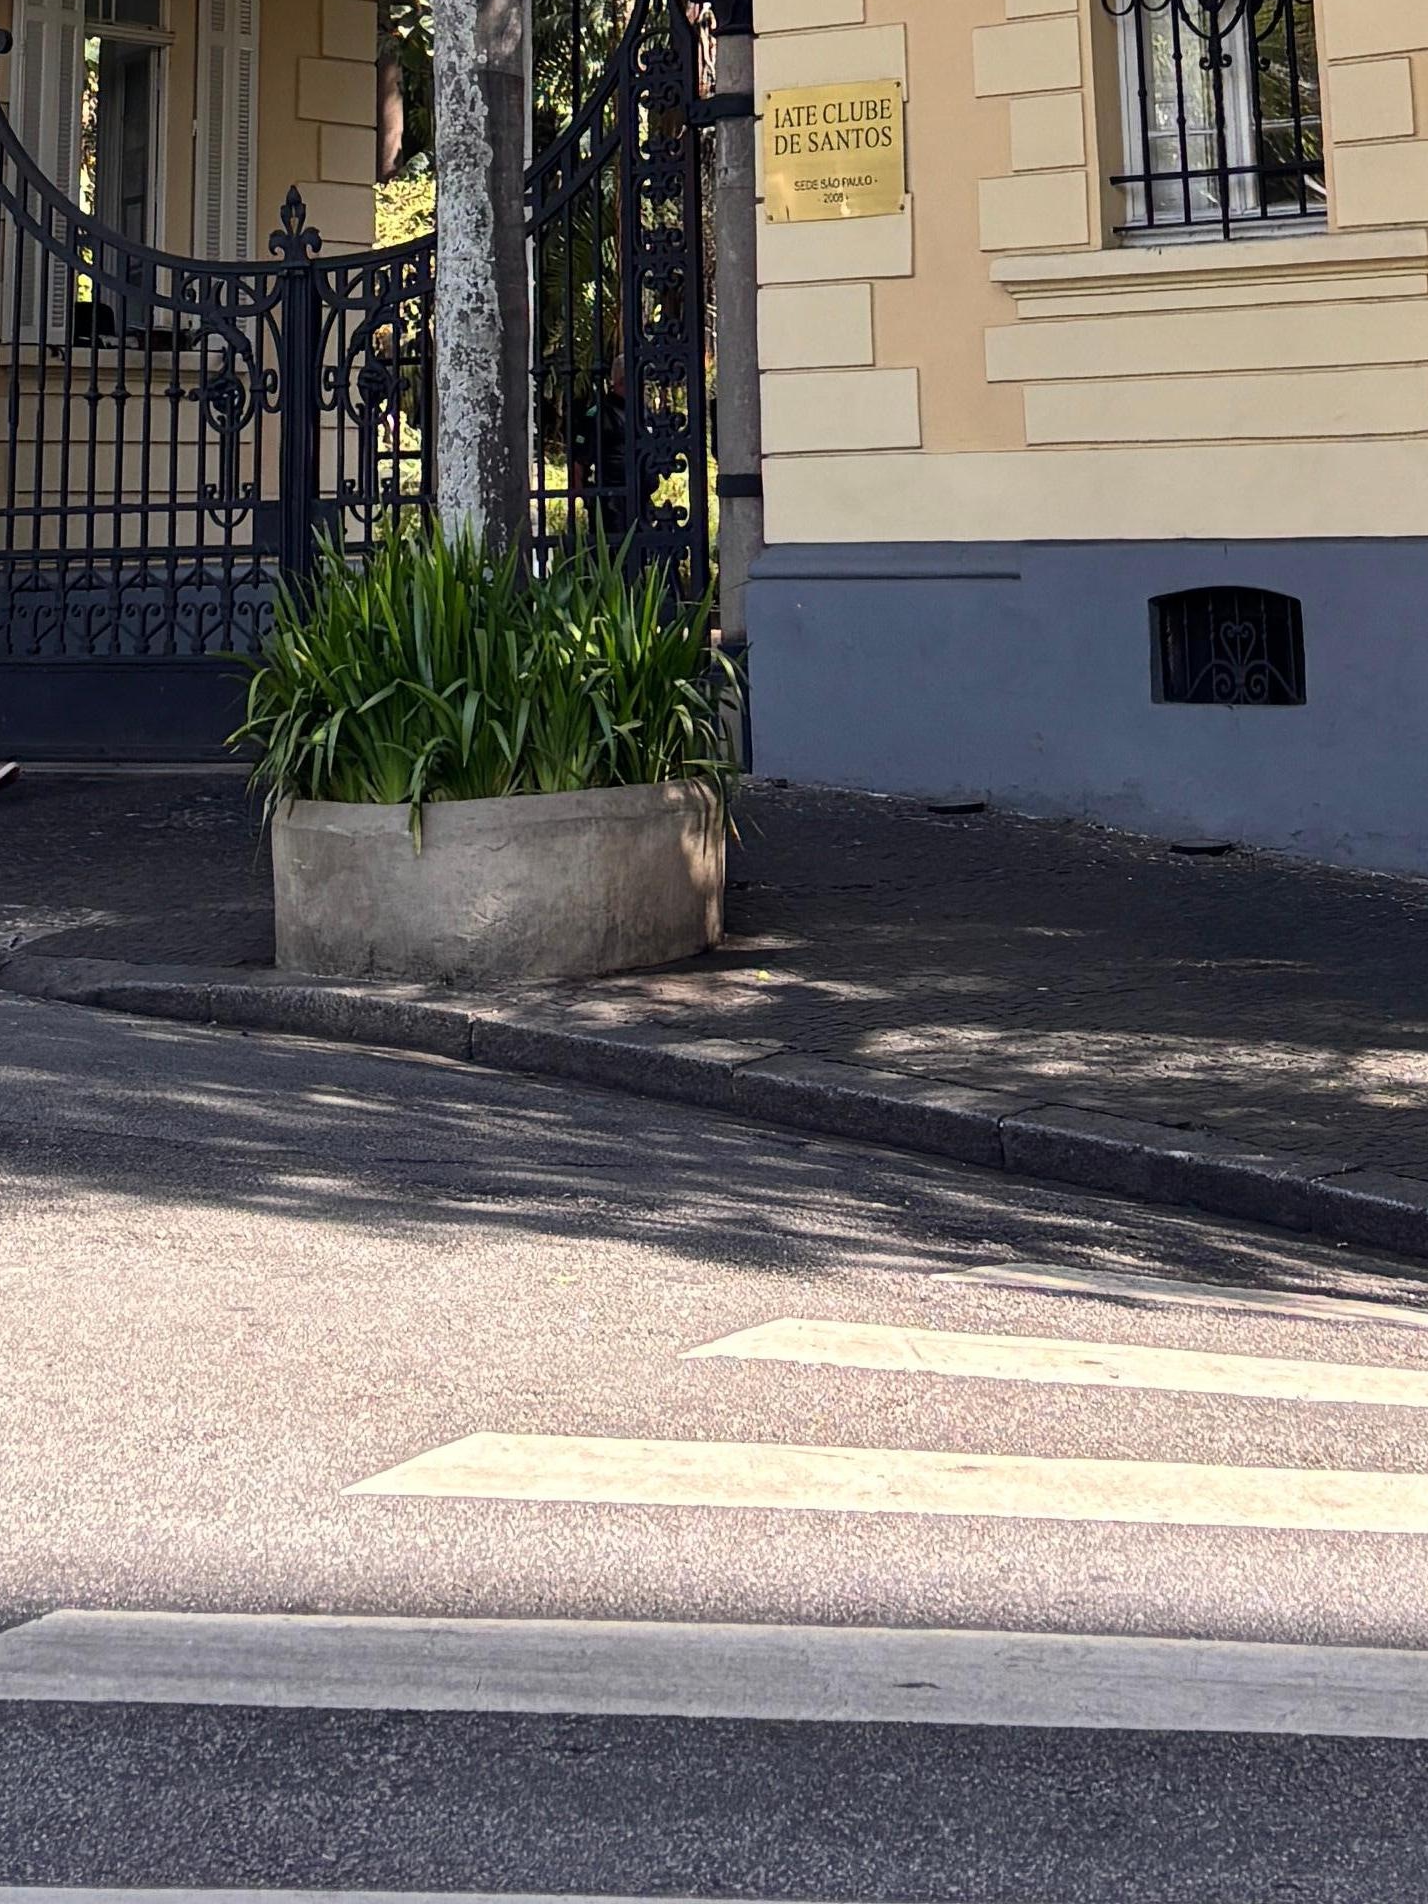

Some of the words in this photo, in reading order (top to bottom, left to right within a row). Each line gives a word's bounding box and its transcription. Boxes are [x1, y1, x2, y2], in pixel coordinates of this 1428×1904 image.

[774, 105, 818, 129] IATE
[822, 98, 893, 125] CLUBE
[774, 133, 802, 156] DE
[808, 125, 893, 154] SANTOS
